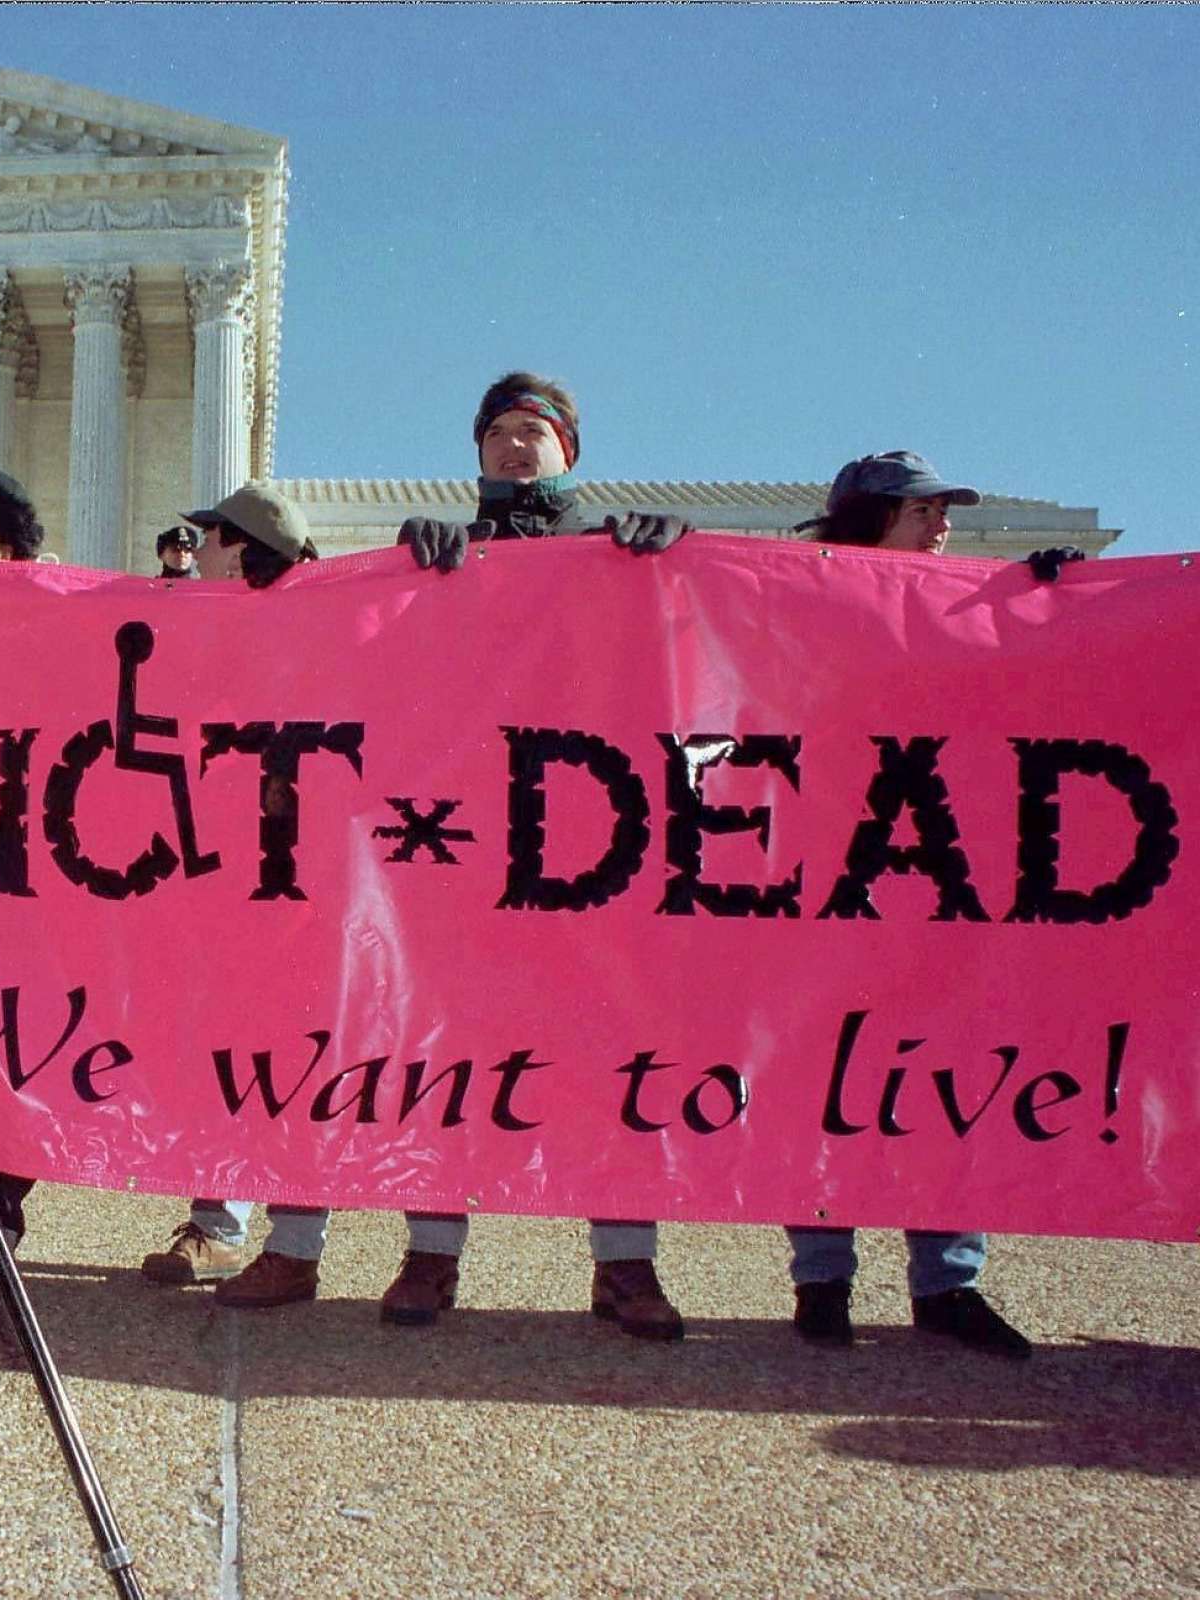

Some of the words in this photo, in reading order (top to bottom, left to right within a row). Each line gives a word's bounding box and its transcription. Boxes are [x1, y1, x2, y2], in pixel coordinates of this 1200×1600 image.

[495, 725, 1181, 926] DEAD
[615, 1050, 749, 1135] to
[821, 1010, 1131, 1146] live!
